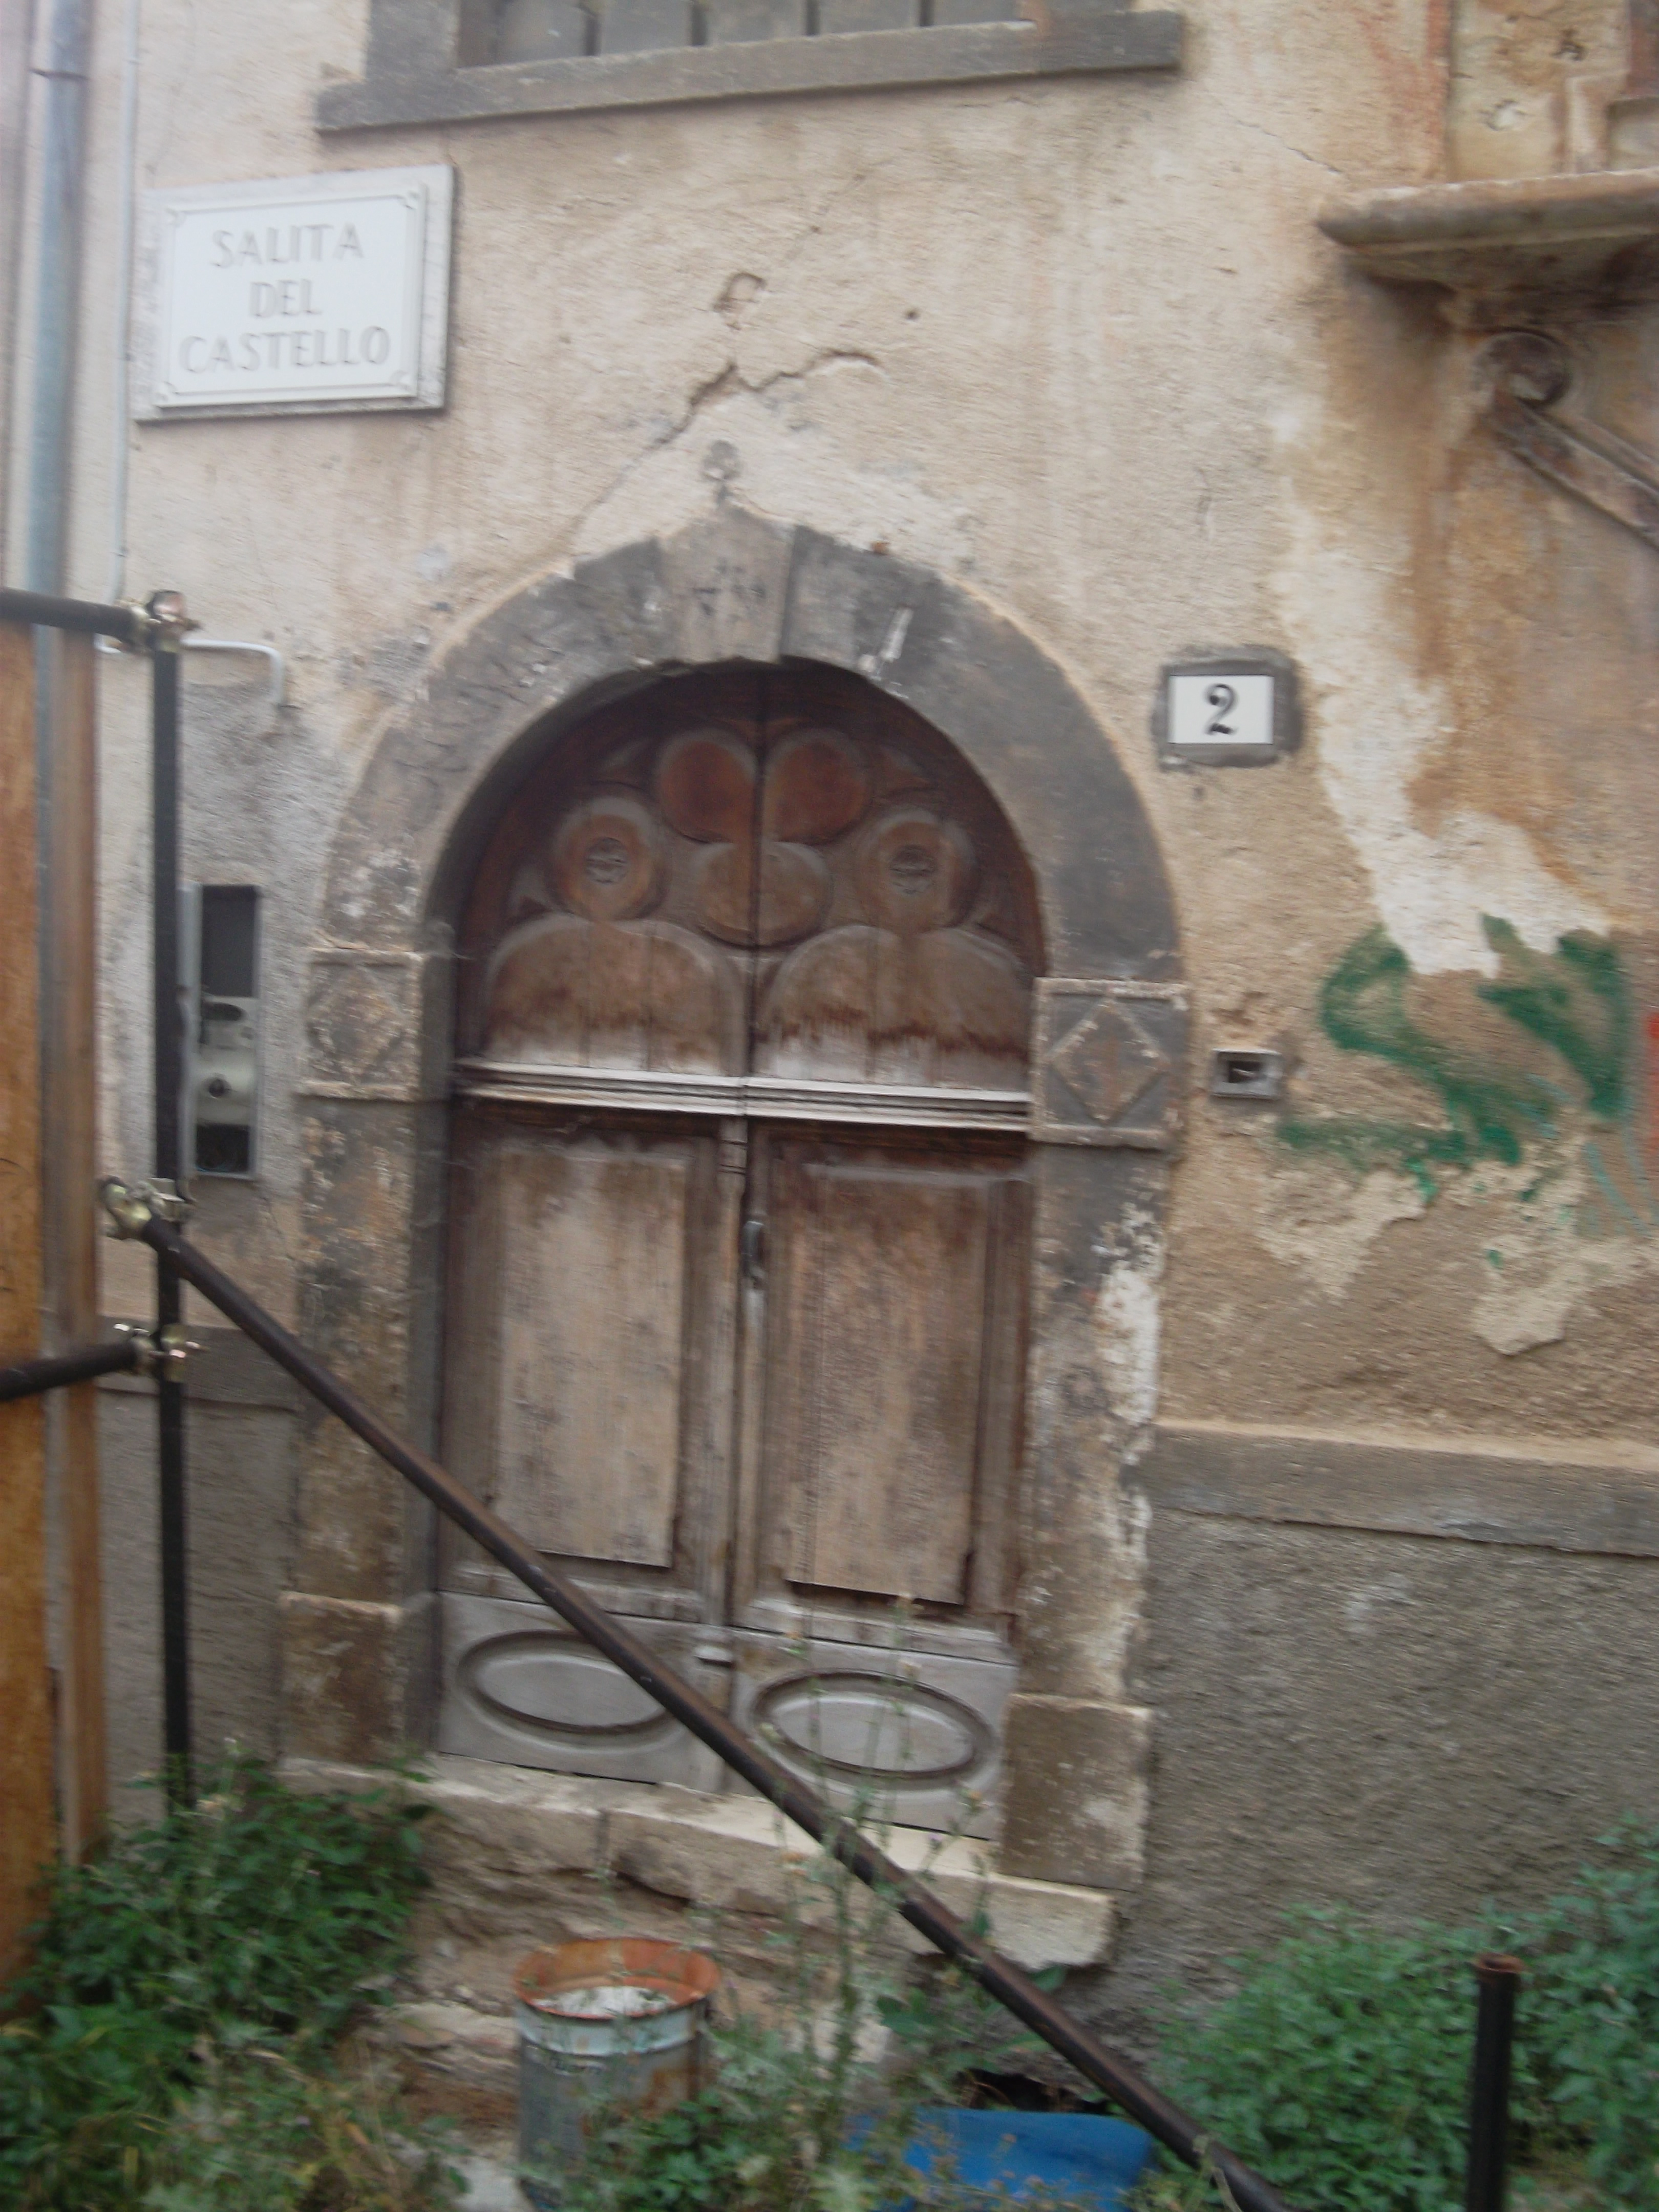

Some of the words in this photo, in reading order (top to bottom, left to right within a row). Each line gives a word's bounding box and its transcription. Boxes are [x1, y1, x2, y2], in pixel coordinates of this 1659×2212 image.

[210, 222, 365, 268] SALITA
[248, 278, 323, 318] DEL
[178, 325, 391, 374] CASTELLO
[1205, 683, 1238, 735] 2
